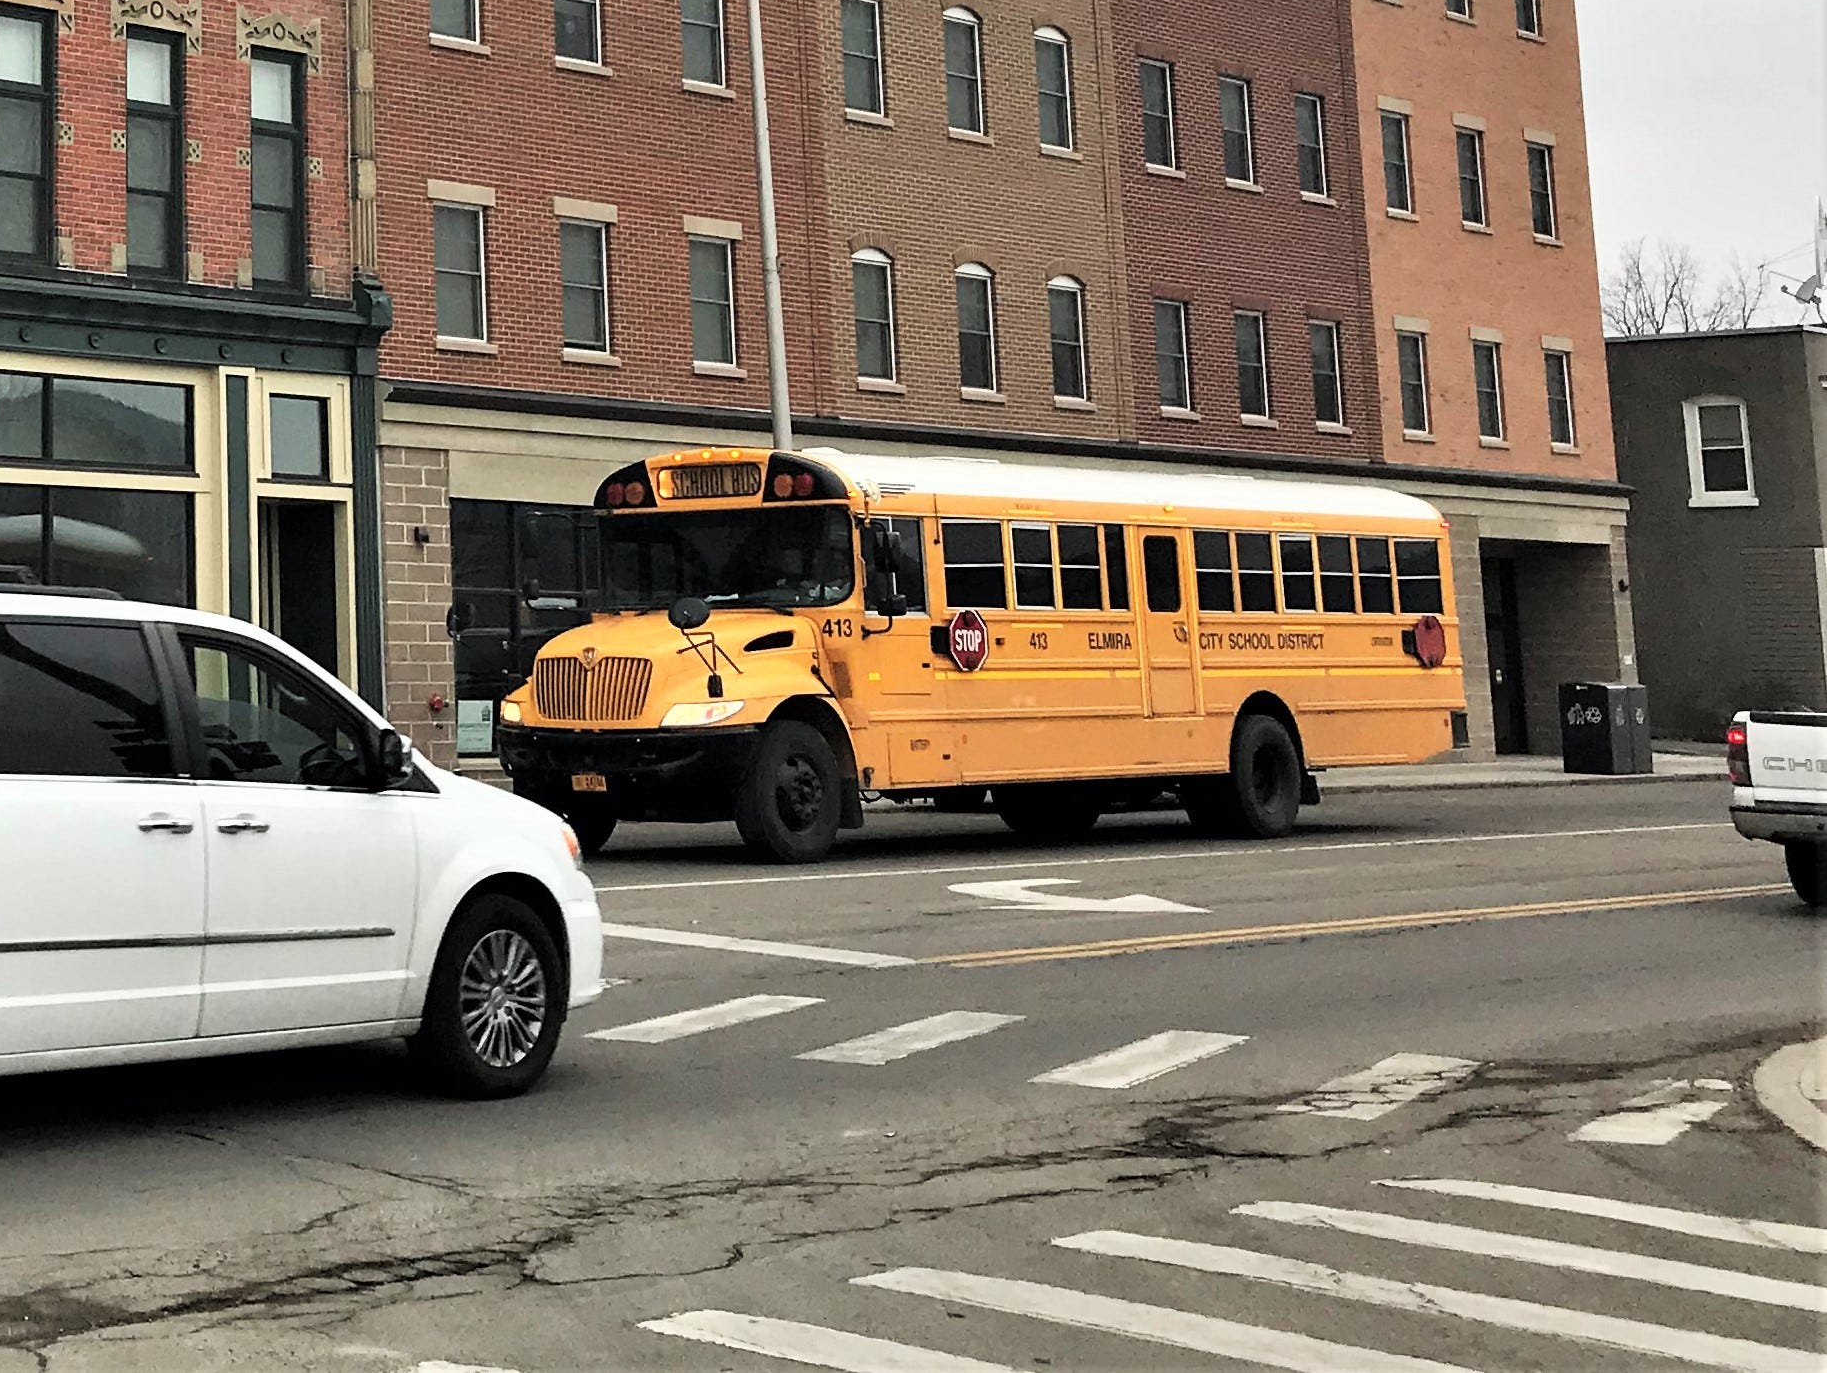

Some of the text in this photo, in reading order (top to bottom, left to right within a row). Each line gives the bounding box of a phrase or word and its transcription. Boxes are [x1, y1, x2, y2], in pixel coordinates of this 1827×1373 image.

[671, 464, 760, 497] SCHOOL BUS
[822, 618, 853, 638] 413
[954, 628, 982, 653] STOP
[1029, 631, 1048, 650] 413
[1088, 632, 1324, 651] ELMIRA CITY SCHOOL DISTRICT
